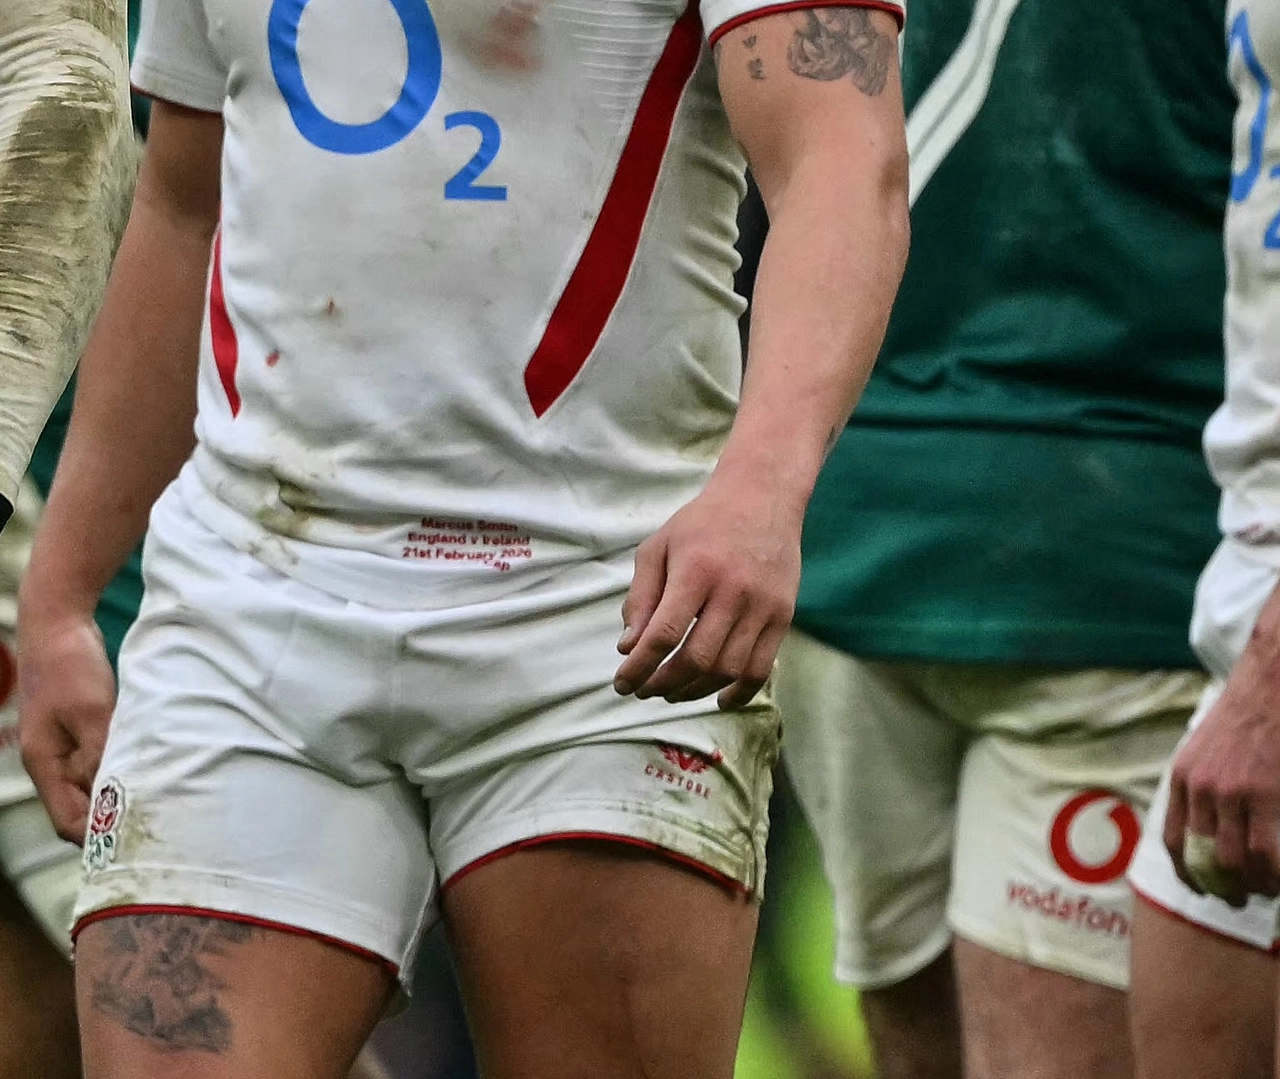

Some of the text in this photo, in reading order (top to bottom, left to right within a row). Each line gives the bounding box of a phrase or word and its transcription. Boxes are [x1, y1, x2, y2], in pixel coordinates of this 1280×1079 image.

[407, 531, 467, 545] England
[470, 536, 479, 545] v
[403, 546, 431, 558] 21st
[435, 547, 496, 561] February
[1007, 880, 1130, 938] vodafon
